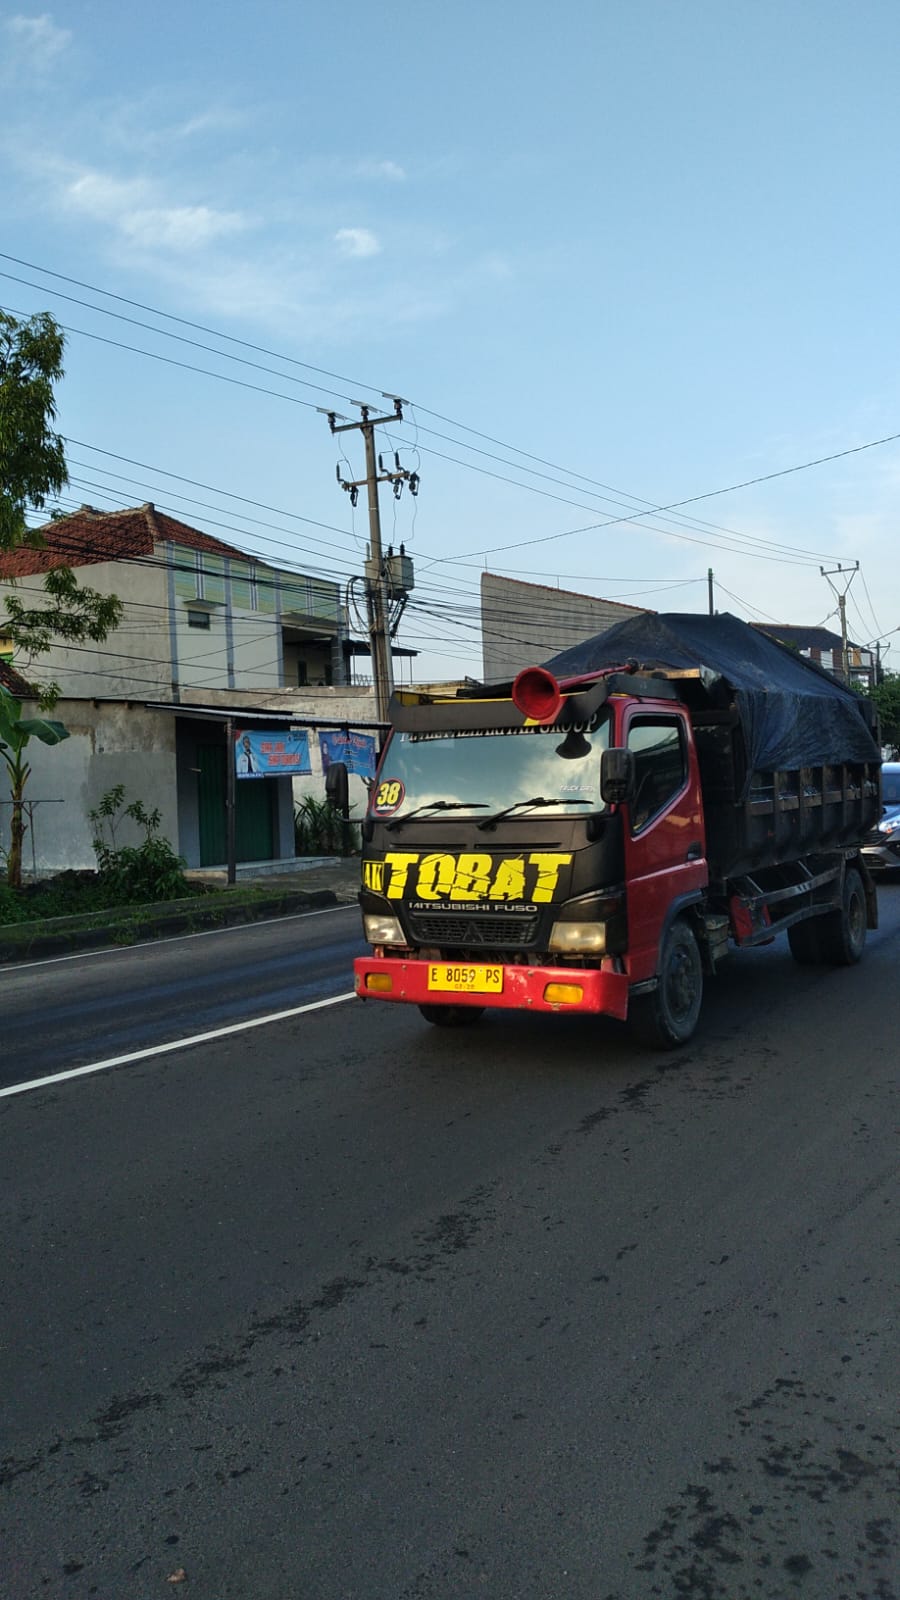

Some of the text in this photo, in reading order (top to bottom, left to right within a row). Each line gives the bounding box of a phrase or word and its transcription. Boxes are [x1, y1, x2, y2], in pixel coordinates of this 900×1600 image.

[377, 782, 401, 805] 38
[384, 853, 573, 903] TOBAT
[409, 902, 538, 912] MITSUBISHI FUSO
[431, 968, 500, 984] E 8059 PS
